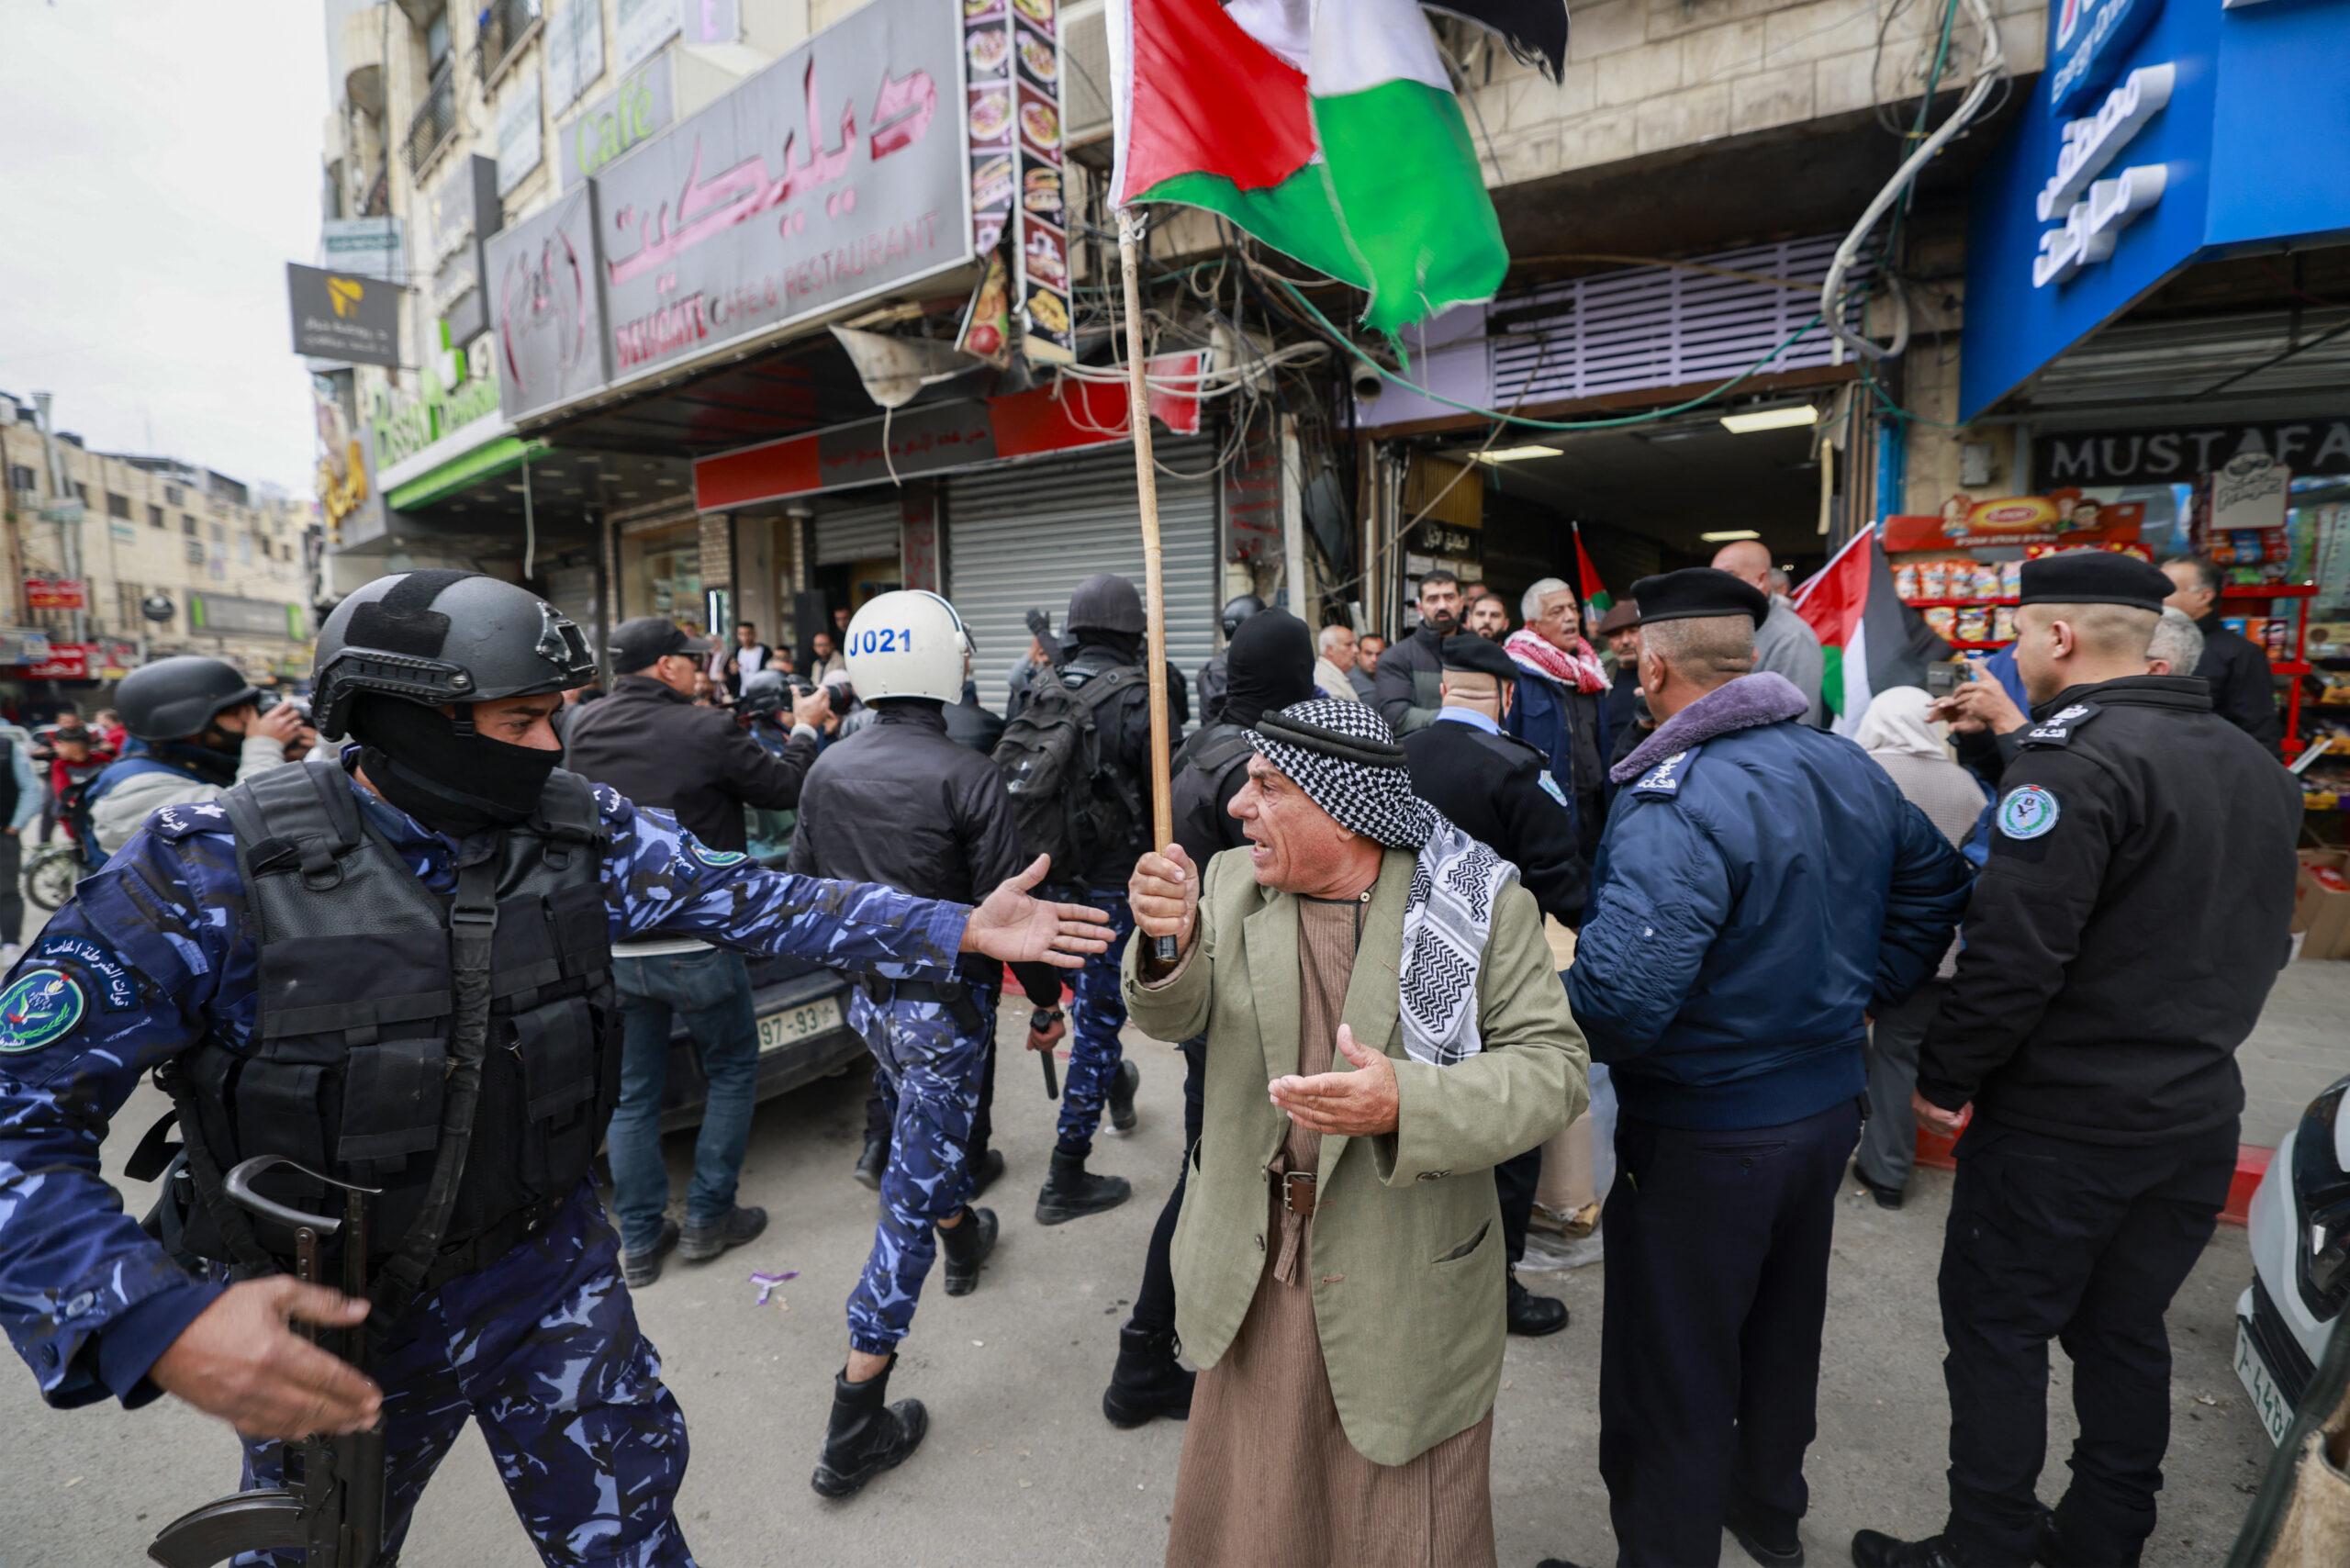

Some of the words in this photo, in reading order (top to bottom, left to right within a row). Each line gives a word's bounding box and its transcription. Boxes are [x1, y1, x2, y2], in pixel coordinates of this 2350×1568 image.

[785, 212, 938, 301] RESTAURANT
[2051, 421, 2350, 479] MUSTAFA
[849, 628, 912, 657] J021
[81, 945, 125, 980] الشرطة
